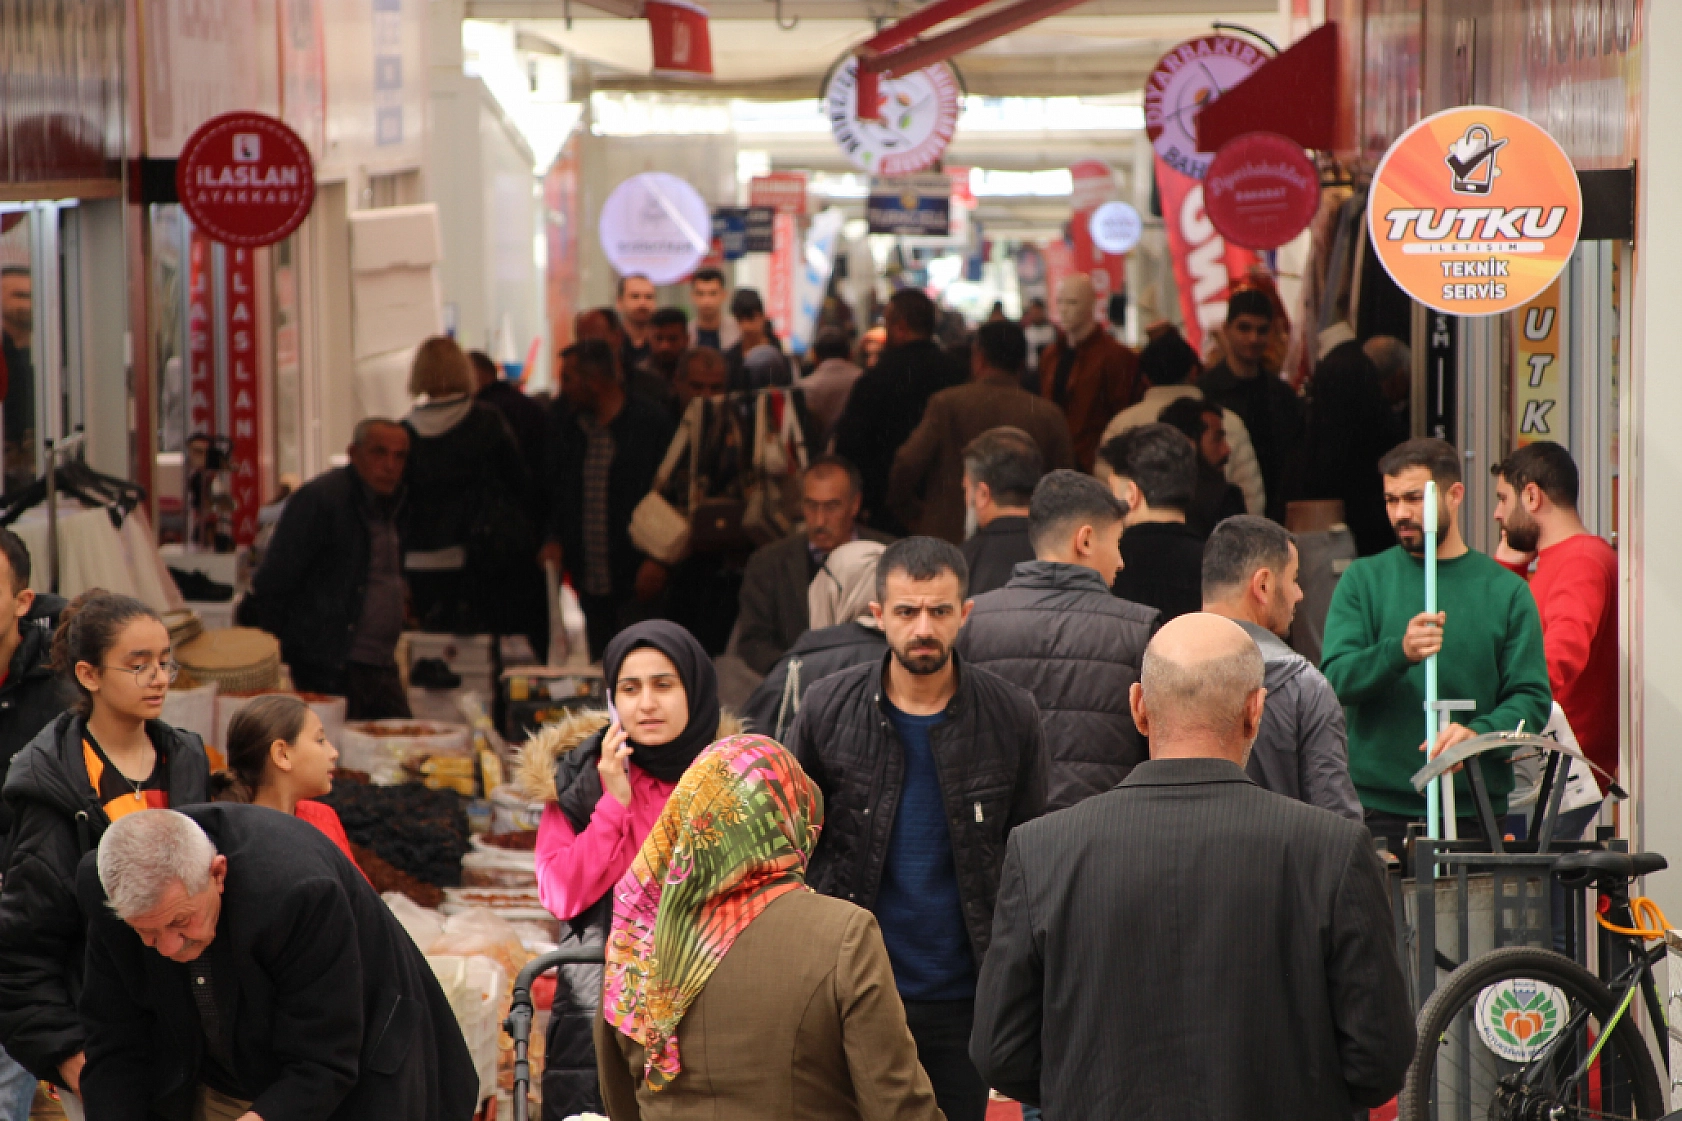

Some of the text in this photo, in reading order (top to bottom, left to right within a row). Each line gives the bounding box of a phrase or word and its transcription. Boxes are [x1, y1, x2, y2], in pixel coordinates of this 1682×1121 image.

[1385, 206, 1567, 240] TUTKU
[1440, 255, 1509, 277] TEKNİK
[1442, 279, 1507, 300] SERVİS
[1431, 315, 1451, 349] SM
[1520, 306, 1556, 433] UTK
